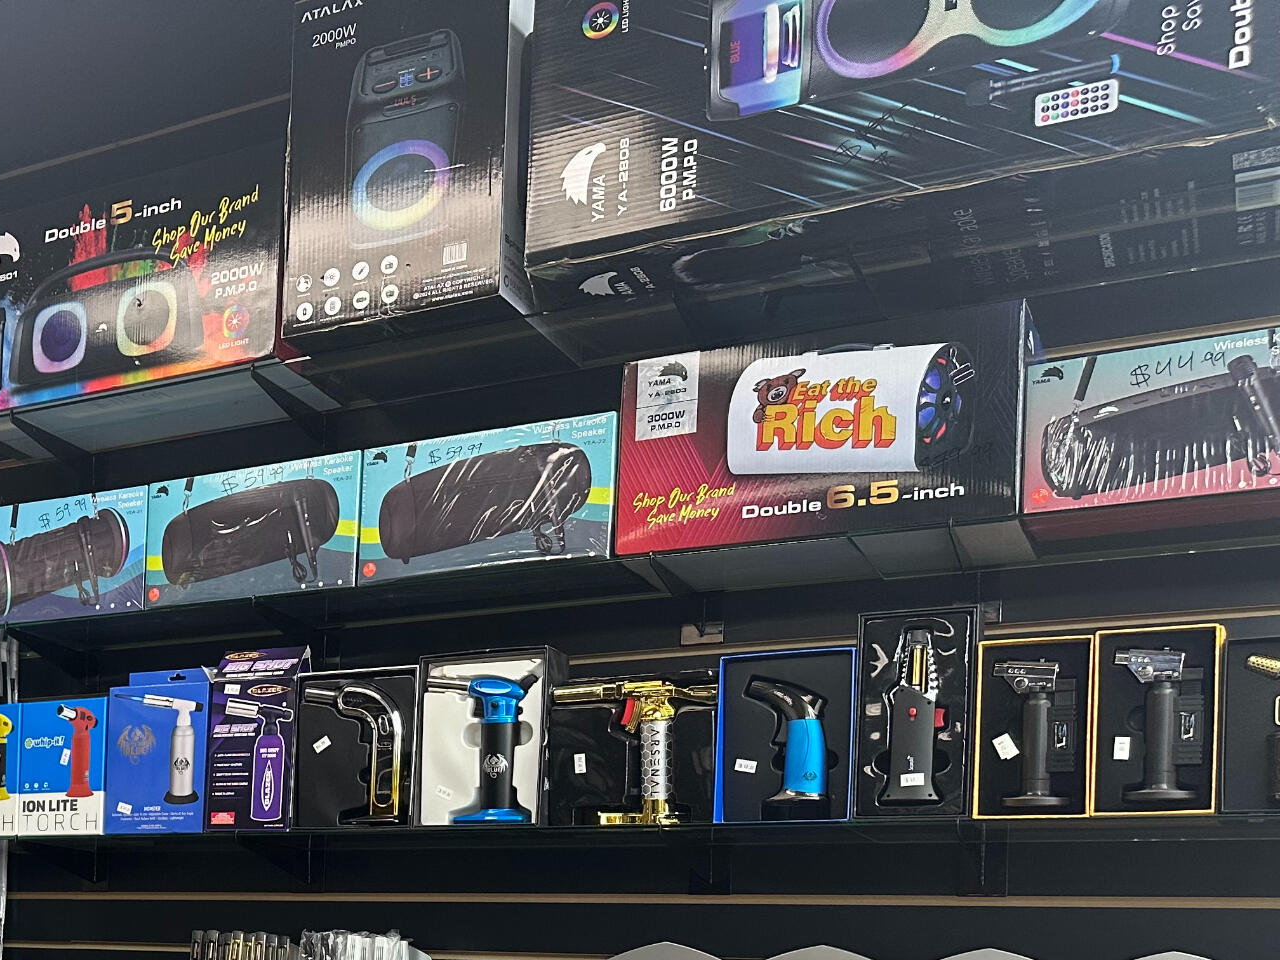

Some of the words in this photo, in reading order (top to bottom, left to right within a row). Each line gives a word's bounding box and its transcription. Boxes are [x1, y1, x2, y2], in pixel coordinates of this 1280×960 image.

[312, 23, 357, 48] 2000W
[1156, 5, 1180, 56] Shop
[335, 37, 356, 49] PMPO
[660, 137, 679, 212] 6000W
[591, 174, 606, 223] YAMA
[45, 217, 107, 243] Double
[152, 224, 186, 253] Shop
[190, 208, 216, 237] Our
[219, 184, 260, 224] Brand
[170, 241, 200, 267] Save
[204, 219, 246, 251] Money
[211, 263, 264, 285] 2000W
[1214, 336, 1269, 351] Wireless
[648, 378, 672, 388] YAMA
[793, 382, 830, 401] Eat
[836, 376, 878, 395] the
[647, 410, 685, 424] 3000W
[758, 397, 897, 450] Rich
[571, 427, 606, 439] Speaker
[323, 464, 353, 475] Speaker
[633, 494, 666, 513] Shop
[669, 487, 694, 504] Our
[695, 482, 735, 501] Brand
[742, 499, 821, 519] Double
[647, 511, 676, 529] Save
[678, 505, 719, 521] Money
[650, 728, 660, 796] ARSENAL
[23, 801, 45, 813] ION
[48, 799, 78, 811] LITE
[22, 813, 98, 833] TORCH
